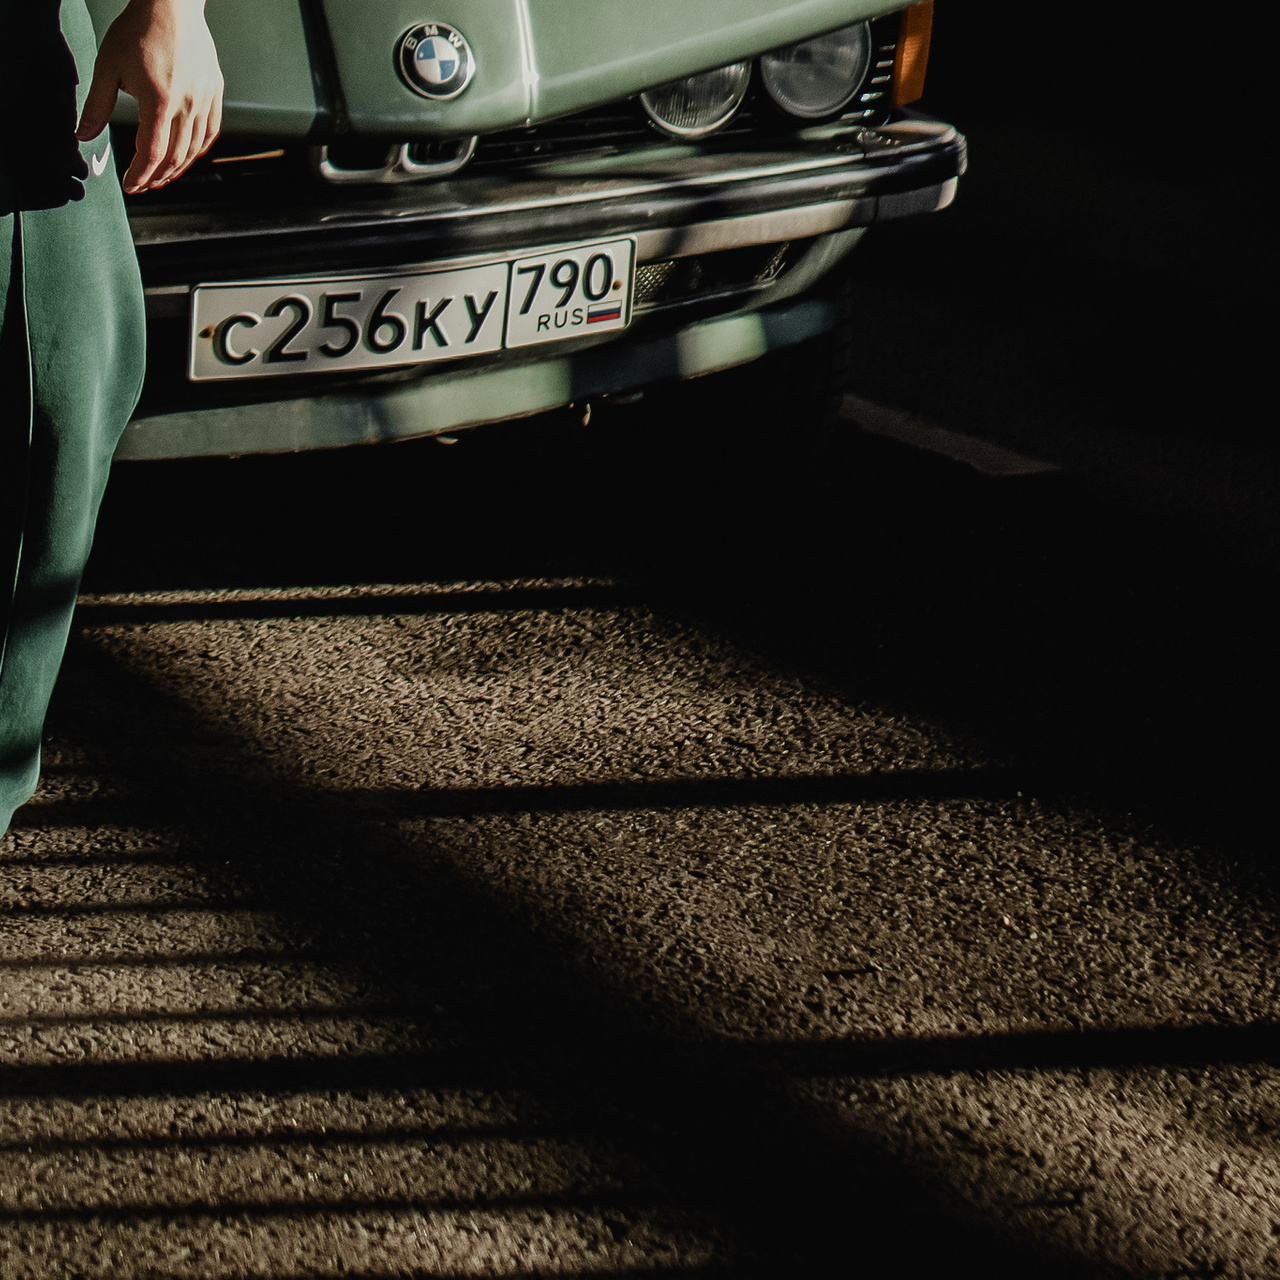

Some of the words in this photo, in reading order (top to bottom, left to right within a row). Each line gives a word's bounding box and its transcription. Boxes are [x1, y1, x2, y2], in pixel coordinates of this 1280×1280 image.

[405, 25, 462, 50] BMW
[517, 252, 613, 316] 790
[537, 308, 584, 333] RUS
